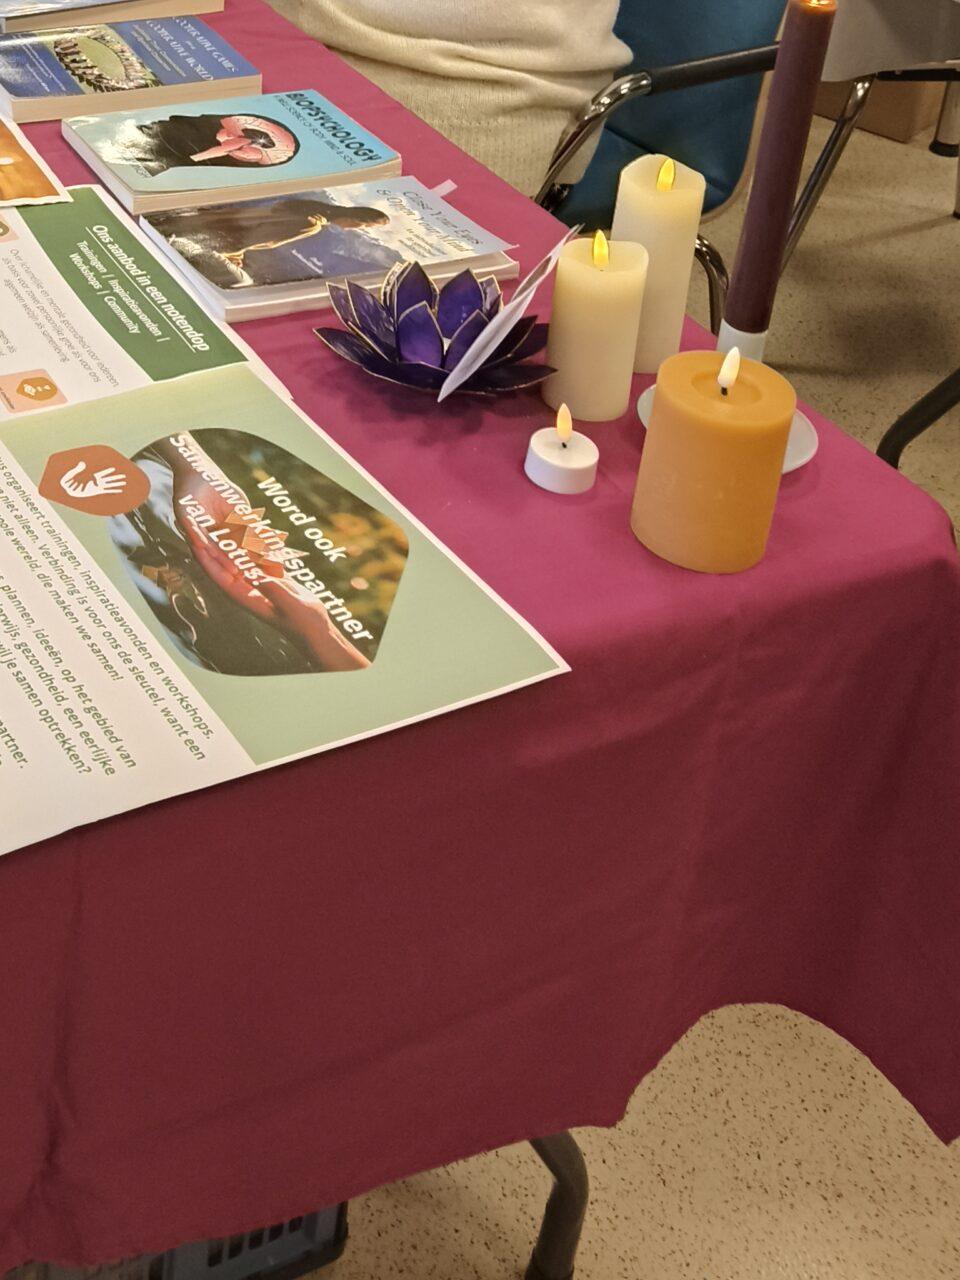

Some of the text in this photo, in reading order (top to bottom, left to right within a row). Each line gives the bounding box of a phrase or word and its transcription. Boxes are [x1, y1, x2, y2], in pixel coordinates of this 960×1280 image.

[286, 92, 380, 161] BIOPSYCHOLOGY
[375, 188, 391, 196] &
[385, 195, 424, 216] Open
[413, 215, 450, 234] Your
[436, 233, 476, 252] Mind
[402, 190, 433, 210] Close
[429, 210, 458, 229] Your
[453, 228, 483, 245] Eyes
[69, 252, 140, 333] Workshops Community
[76, 240, 161, 336] Trainingen Inspiratieavonden
[91, 224, 209, 351] Ons aanbod in een notendop
[170, 434, 373, 640] Samenwerkingspartner
[178, 494, 275, 587] van Lotus!
[257, 476, 346, 562] Word ook
[0, 494, 19, 513] niet
[13, 513, 39, 543] alleen.
[37, 543, 80, 596] Verbinding
[75, 594, 88, 605] is
[83, 605, 107, 628] voor
[101, 630, 122, 650] ons
[116, 650, 133, 665] de
[127, 665, 165, 706] sleutel,
[160, 706, 189, 737] want
[183, 738, 205, 760] een
[2, 470, 45, 520] organiseert
[40, 520, 81, 570] trainingen,
[79, 570, 152, 659] inspiratieavonden
[148, 660, 165, 675] en
[161, 675, 213, 739] workshops.
[10, 537, 42, 572] wereld,
[35, 572, 53, 588] die
[48, 589, 79, 624] maken
[74, 624, 92, 640] we
[86, 641, 124, 681] samen!
[0, 656, 17, 669] je
[11, 669, 43, 707] samen
[38, 708, 92, 773] optrekken?
[13, 641, 68, 706] gezondheid,
[62, 706, 84, 729] een
[78, 730, 115, 775] eerlijke
[32, 628, 63, 667] ideeën,
[60, 668, 77, 683] op
[71, 683, 92, 704] het
[82, 705, 123, 743] gebied
[115, 744, 136, 768] van
